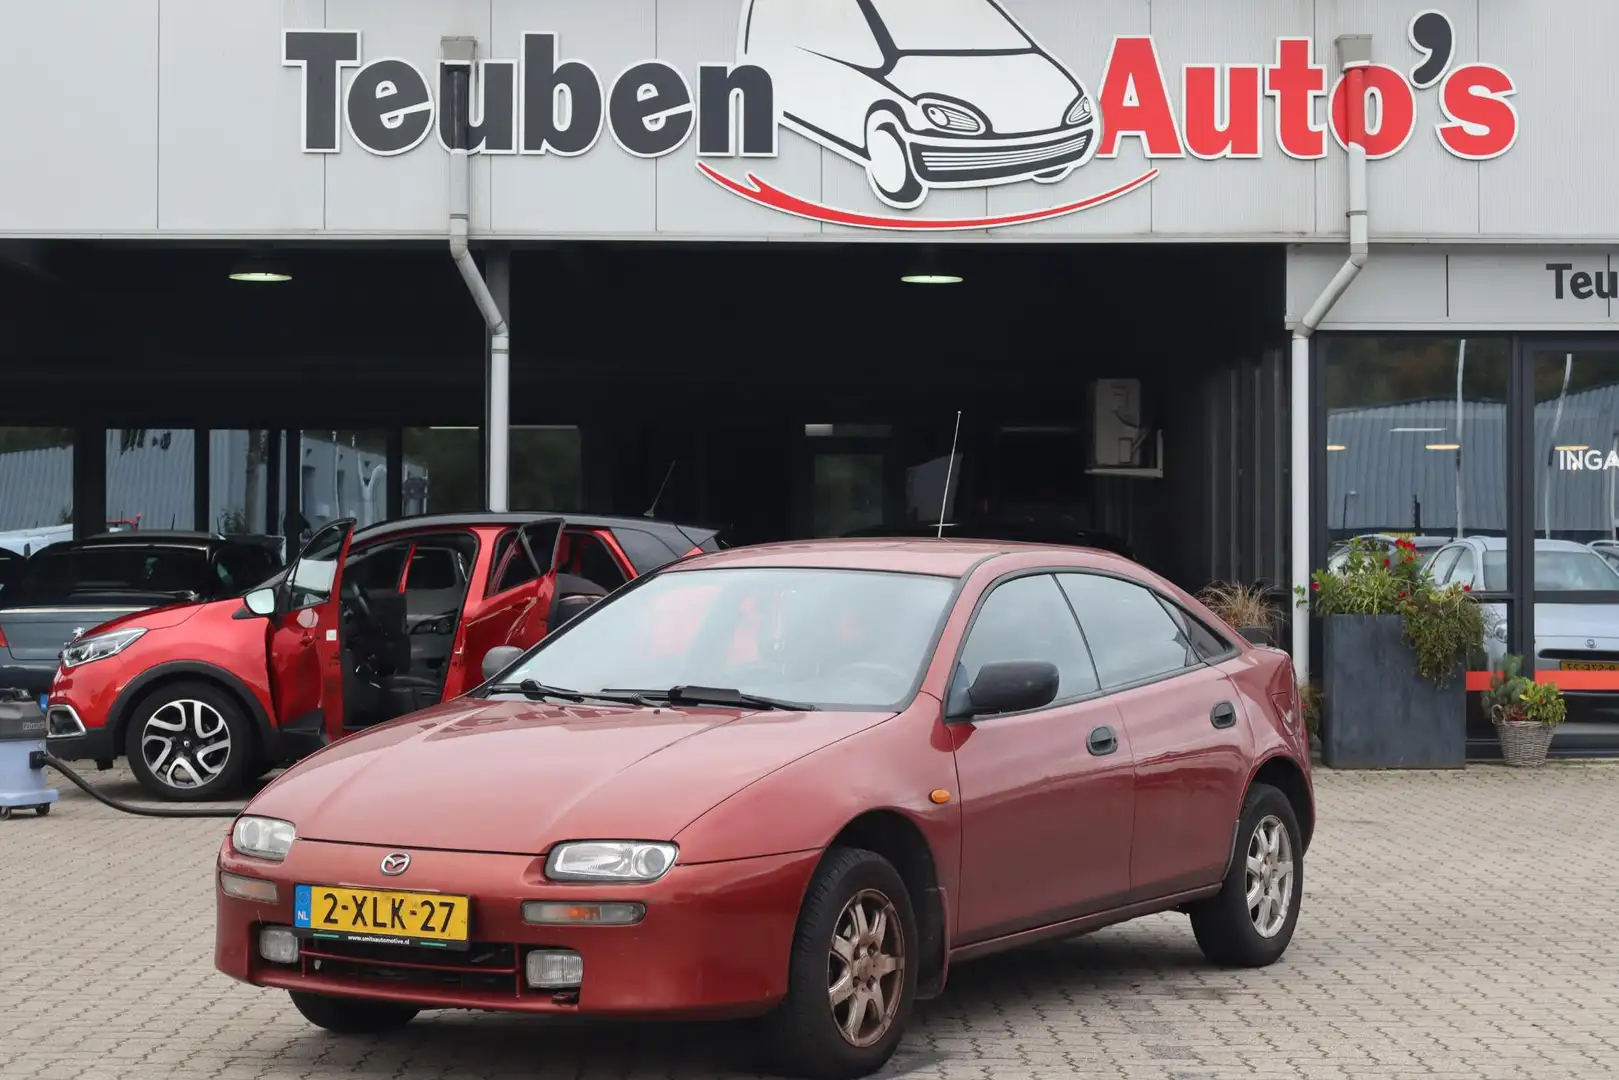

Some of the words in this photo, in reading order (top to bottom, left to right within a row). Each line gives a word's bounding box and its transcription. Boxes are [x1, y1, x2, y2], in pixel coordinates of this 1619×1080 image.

[283, 30, 777, 158] Teuben
[1097, 10, 1519, 160] Auto's
[1546, 263, 1618, 300] Teu
[297, 910, 309, 921] NL
[323, 892, 456, 933] 2-XLK-27
